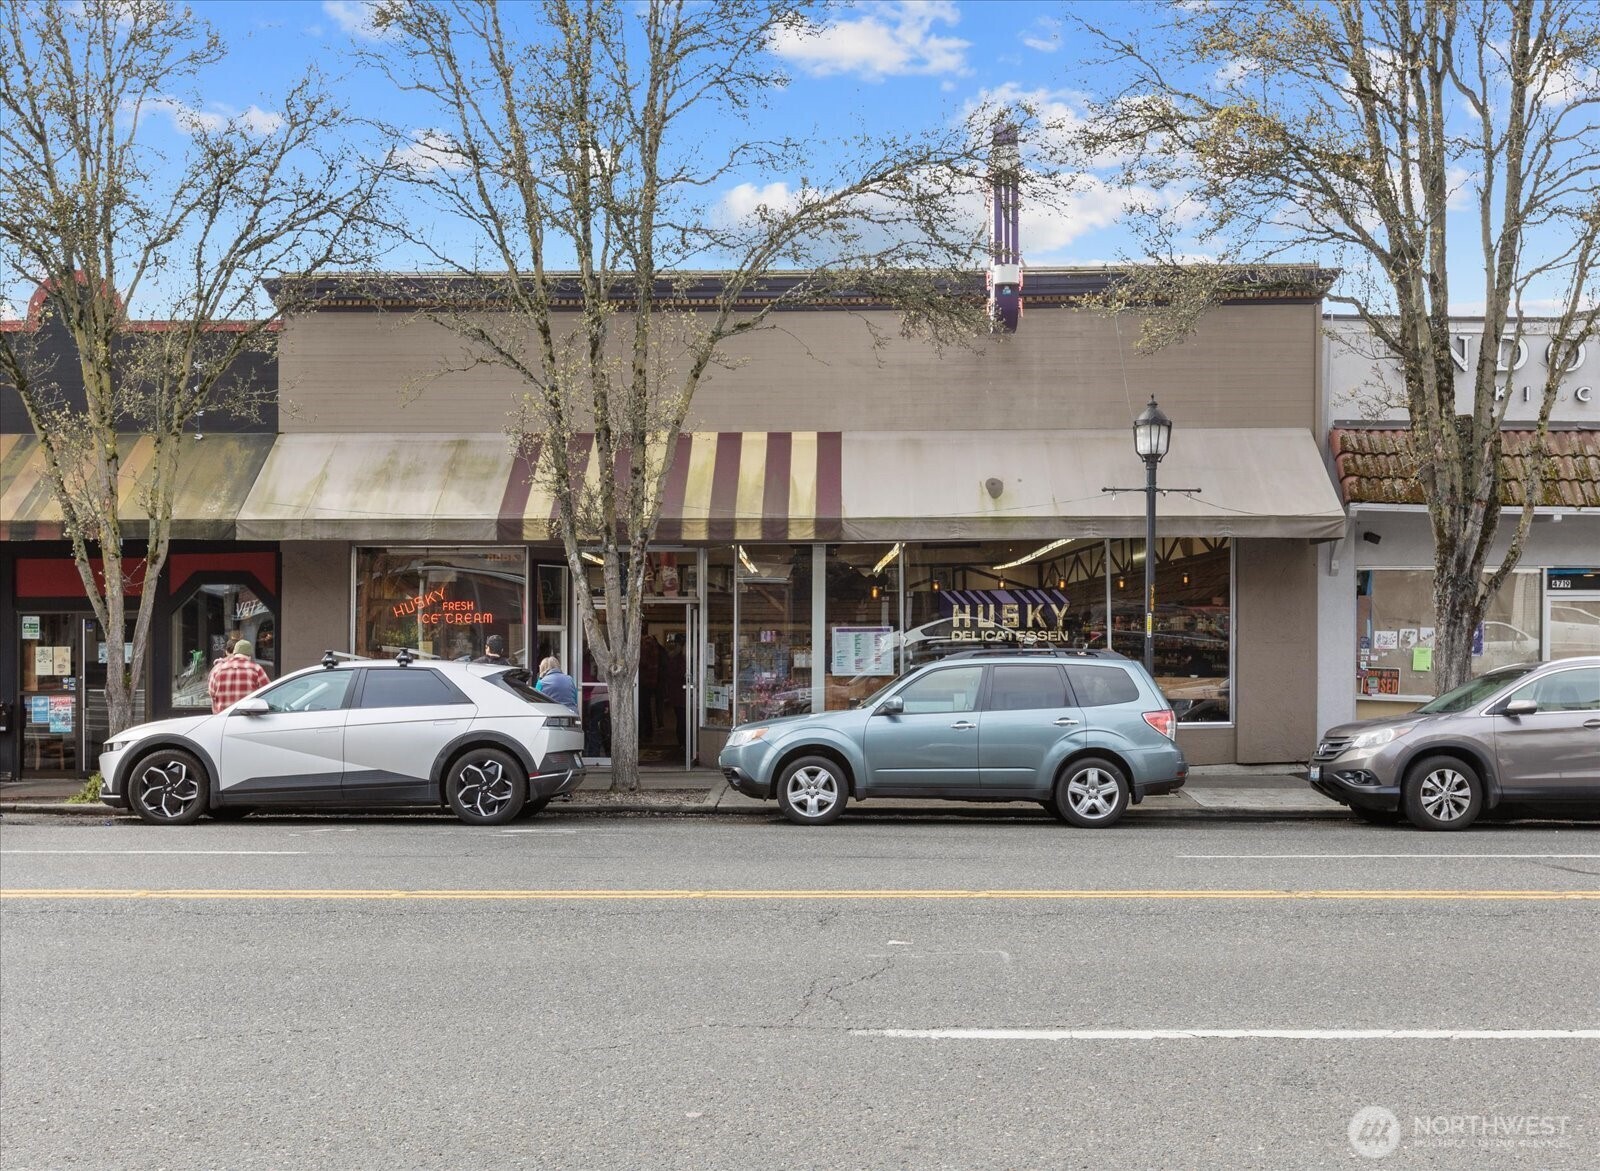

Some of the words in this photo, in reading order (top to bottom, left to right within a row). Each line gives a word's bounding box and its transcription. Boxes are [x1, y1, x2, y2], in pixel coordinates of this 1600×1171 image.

[1493, 385, 1592, 402] KIC
[1552, 579, 1571, 588] 4719
[393, 587, 445, 617] HUSKY
[442, 601, 474, 611] FRESH
[417, 613, 441, 624] ICE
[444, 613, 493, 624] CREAM
[952, 603, 1070, 628] HUSKY
[951, 630, 1069, 641] DELICATESSEN
